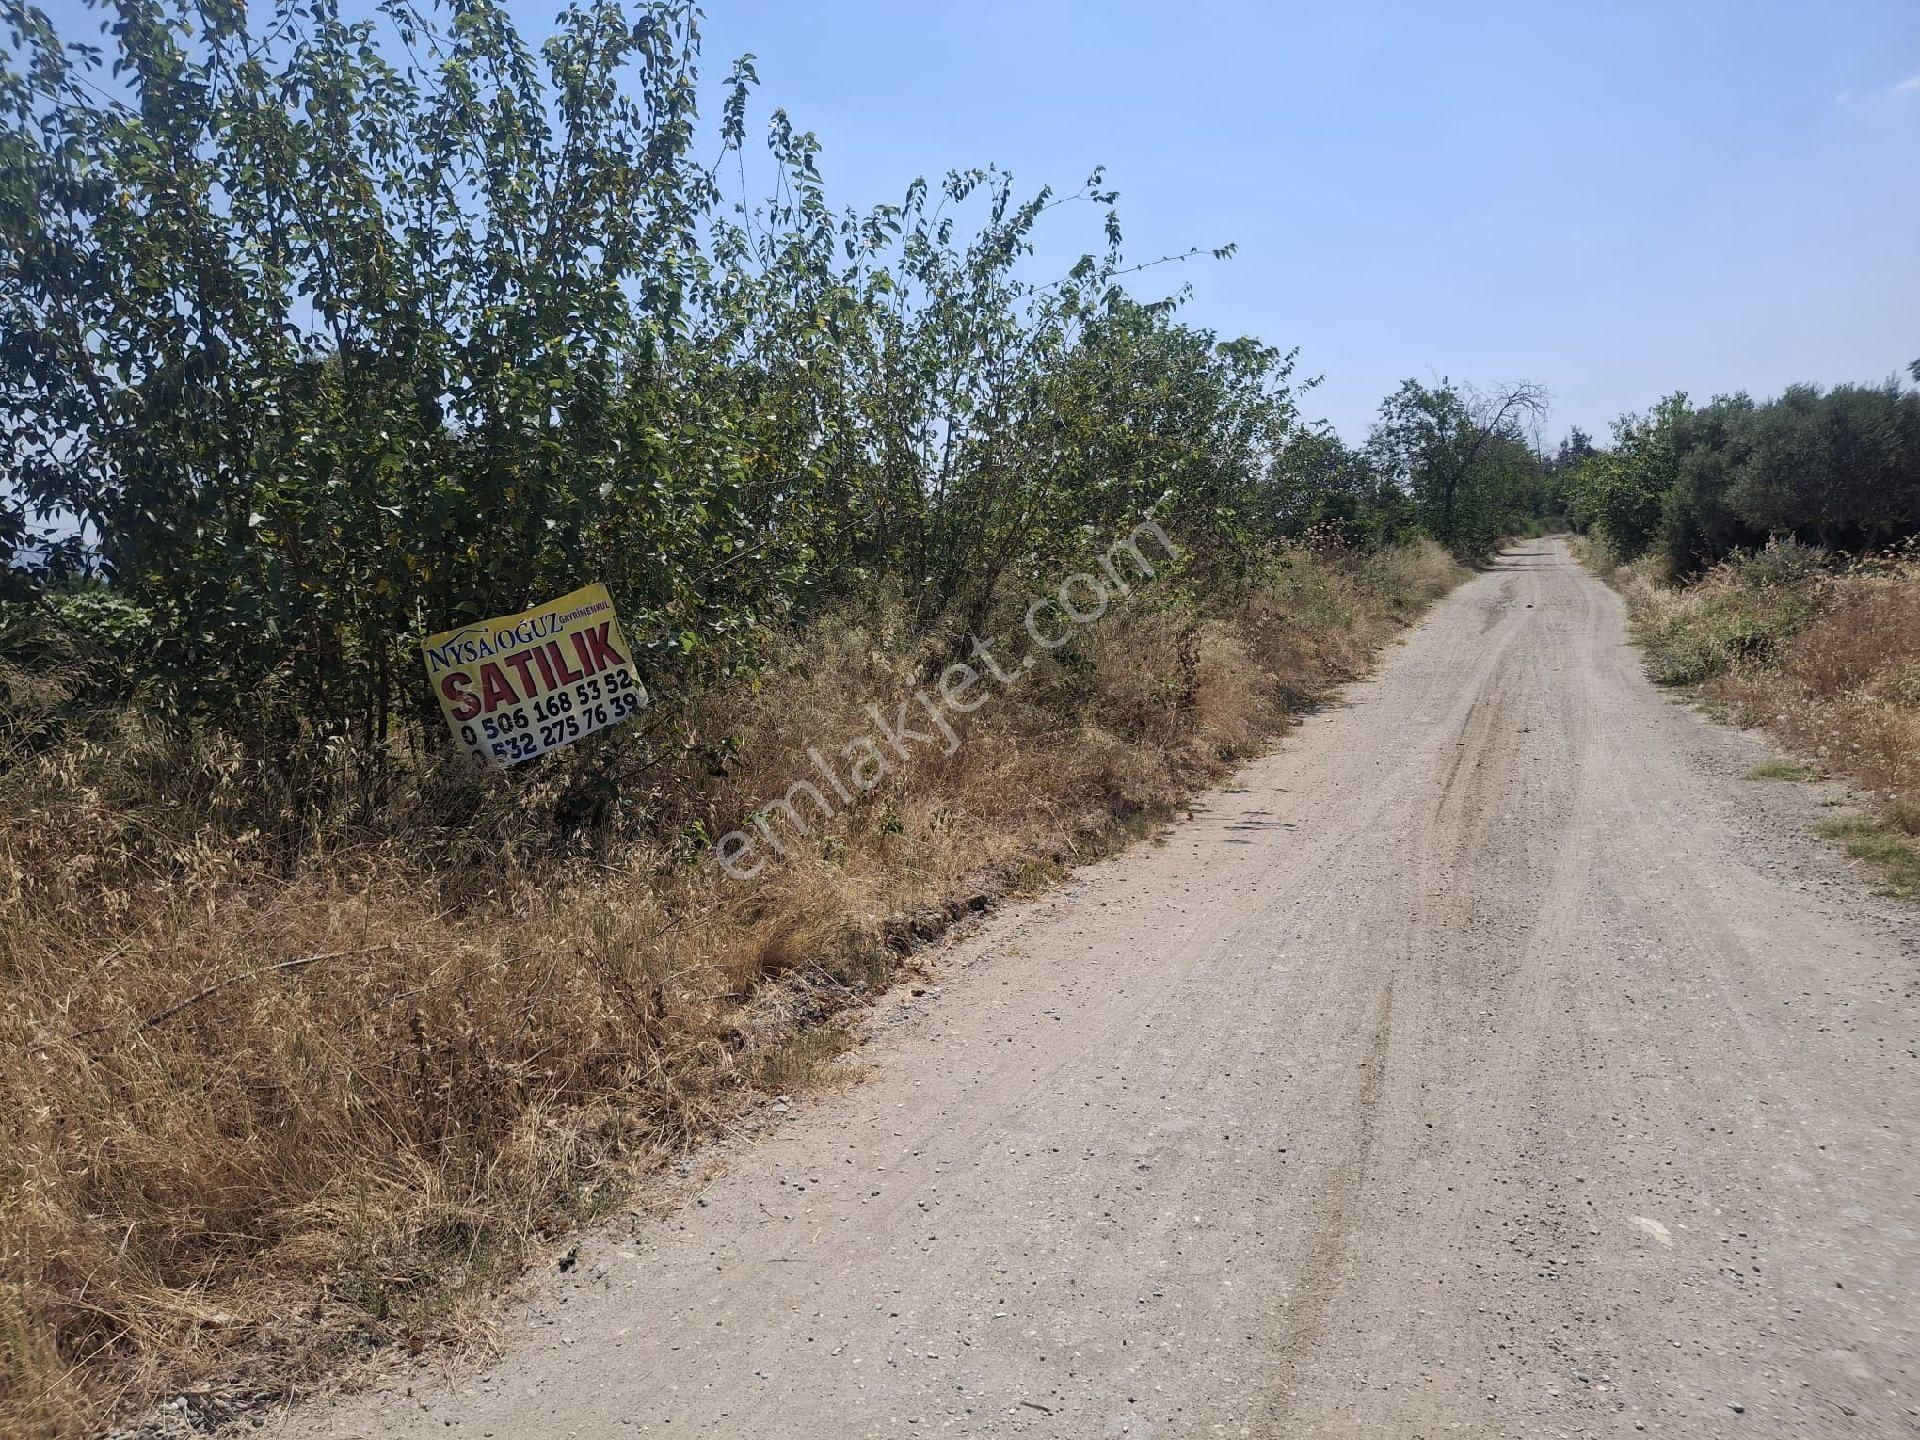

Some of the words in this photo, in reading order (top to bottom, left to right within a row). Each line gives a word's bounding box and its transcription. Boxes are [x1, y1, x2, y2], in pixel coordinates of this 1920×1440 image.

[441, 622, 626, 722] SATILIK
[461, 725, 477, 746] 0
[482, 708, 529, 739] 506
[533, 692, 572, 723] 168
[576, 680, 601, 705] 53
[604, 669, 632, 694] 52
[492, 733, 537, 760] 532
[540, 715, 580, 746] 275
[582, 704, 607, 730] 76
[610, 693, 638, 718] 39
